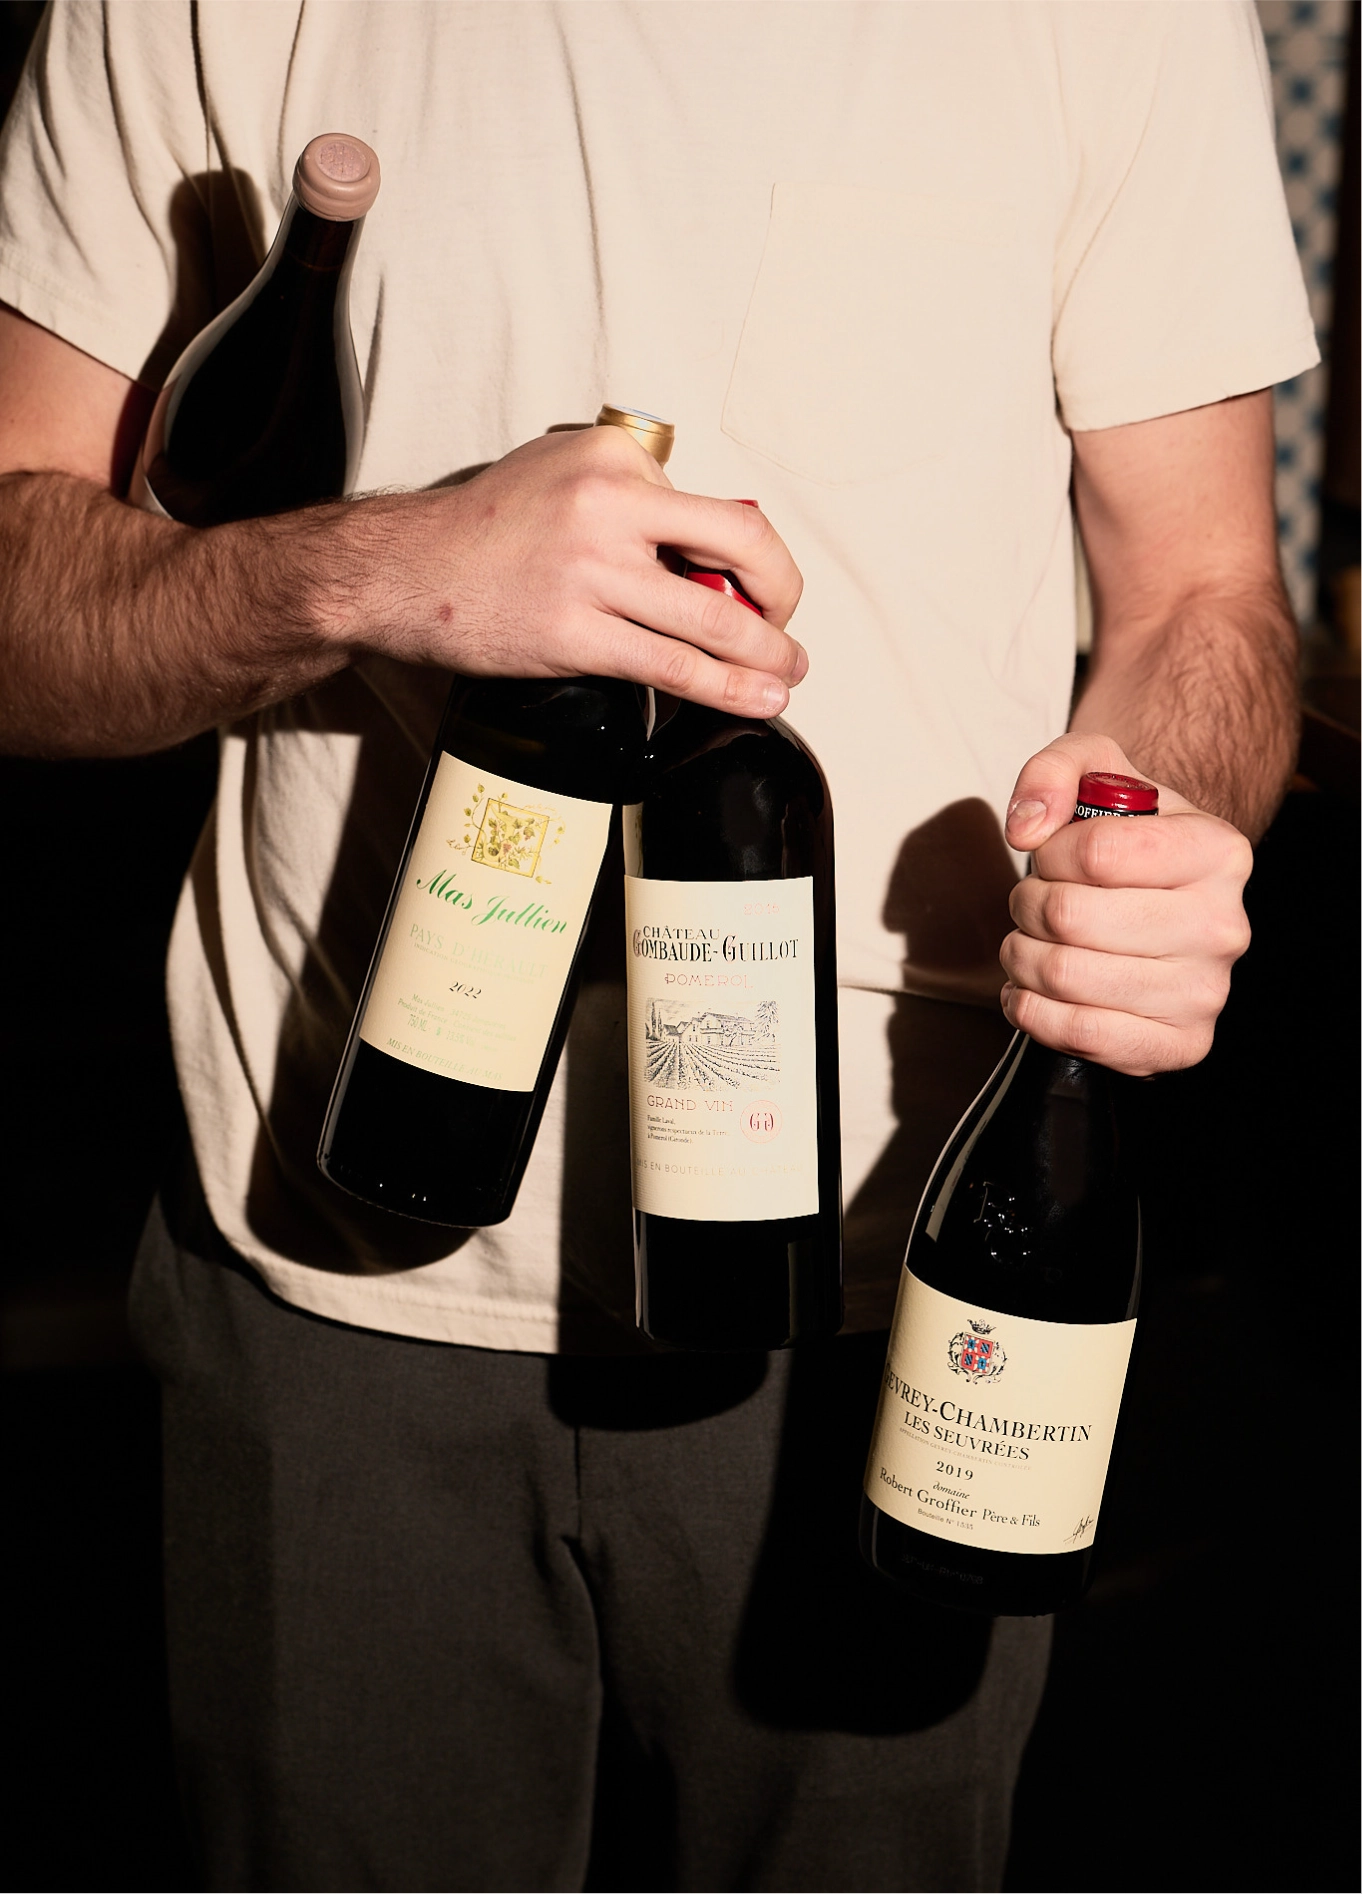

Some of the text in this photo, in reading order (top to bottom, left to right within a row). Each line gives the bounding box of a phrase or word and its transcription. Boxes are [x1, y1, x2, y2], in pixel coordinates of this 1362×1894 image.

[416, 869, 567, 934] Mas Jullien
[410, 923, 444, 950] PAYS
[643, 925, 720, 941] CHÂTEAU
[633, 928, 799, 964] GOMBAUDE-GUILLOT
[449, 980, 482, 1000] 2022
[664, 972, 754, 989] POMEROL
[398, 997, 418, 1013] Produit
[386, 1037, 402, 1050] MIS
[402, 1044, 416, 1056] EN
[415, 1049, 465, 1073] BOUTEILLE
[646, 1094, 734, 1112] GRAND VIN
[650, 1161, 661, 1171] EN
[664, 1164, 725, 1177] BOUTEILLE
[730, 1166, 746, 1177] AU
[904, 1410, 1030, 1461] LES SEUVRÉES
[936, 1460, 974, 1481] 2019
[879, 1466, 1040, 1527] Robert Groffier Père & Fils
[932, 1480, 971, 1500] domaine
